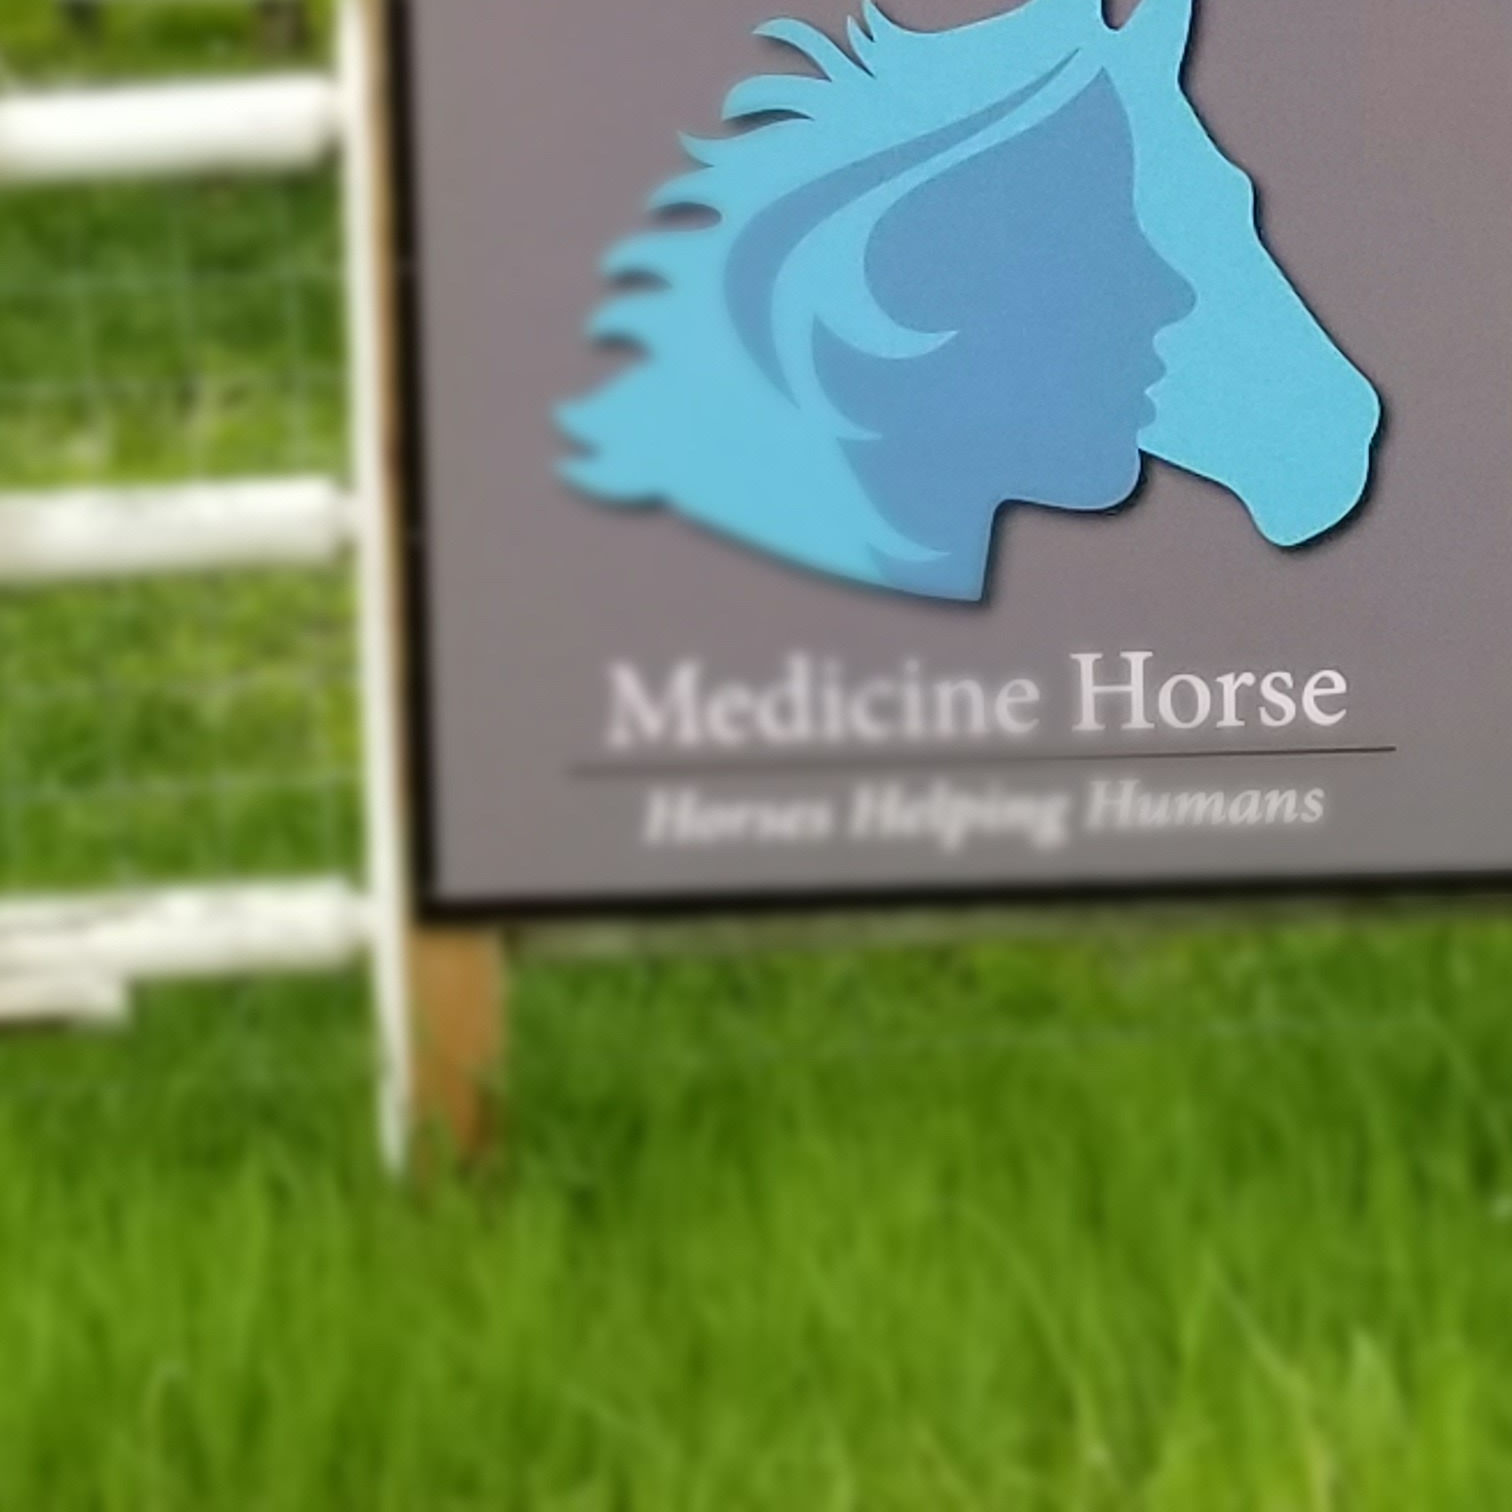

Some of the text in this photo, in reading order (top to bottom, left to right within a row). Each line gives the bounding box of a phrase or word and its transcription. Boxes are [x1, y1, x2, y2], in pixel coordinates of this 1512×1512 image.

[607, 650, 1348, 750] Medicine Horse
[643, 778, 1325, 850] Horses Helping Humans
